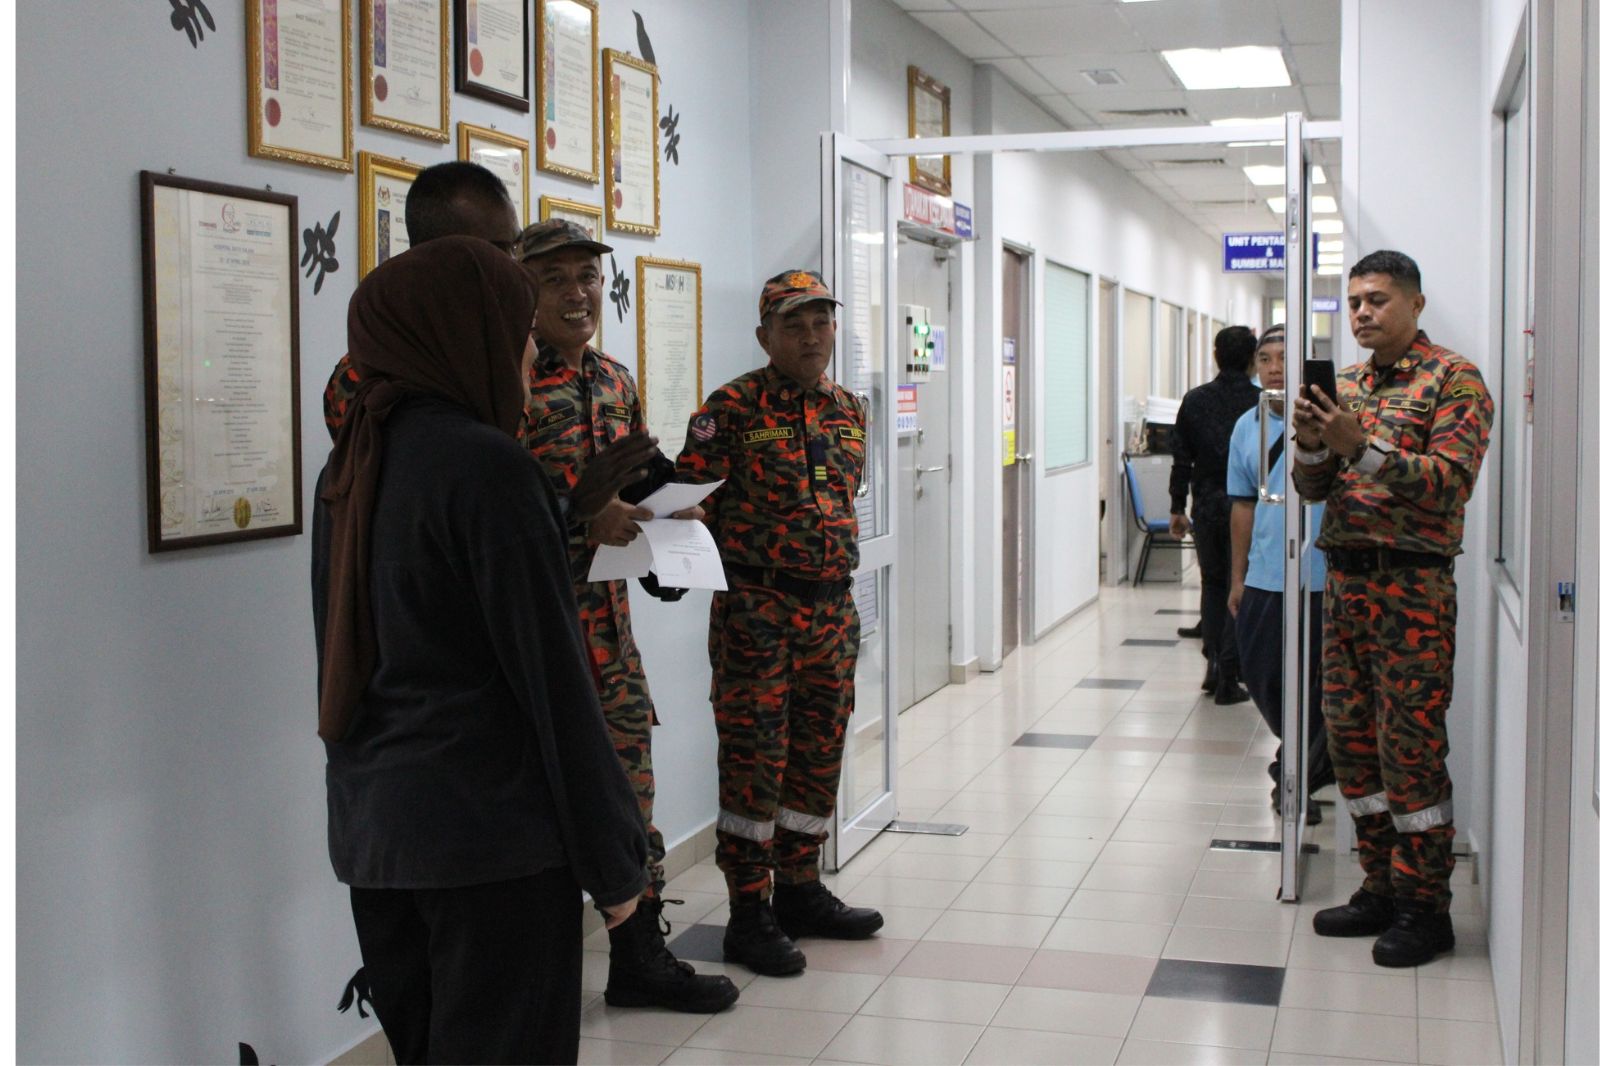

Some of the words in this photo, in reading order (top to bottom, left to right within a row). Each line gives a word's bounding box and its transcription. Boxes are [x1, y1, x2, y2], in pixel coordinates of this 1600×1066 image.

[1228, 236, 1250, 247] UNIT
[1230, 258, 1268, 269] SUMBER
[749, 429, 788, 441] SAHRIMAN
